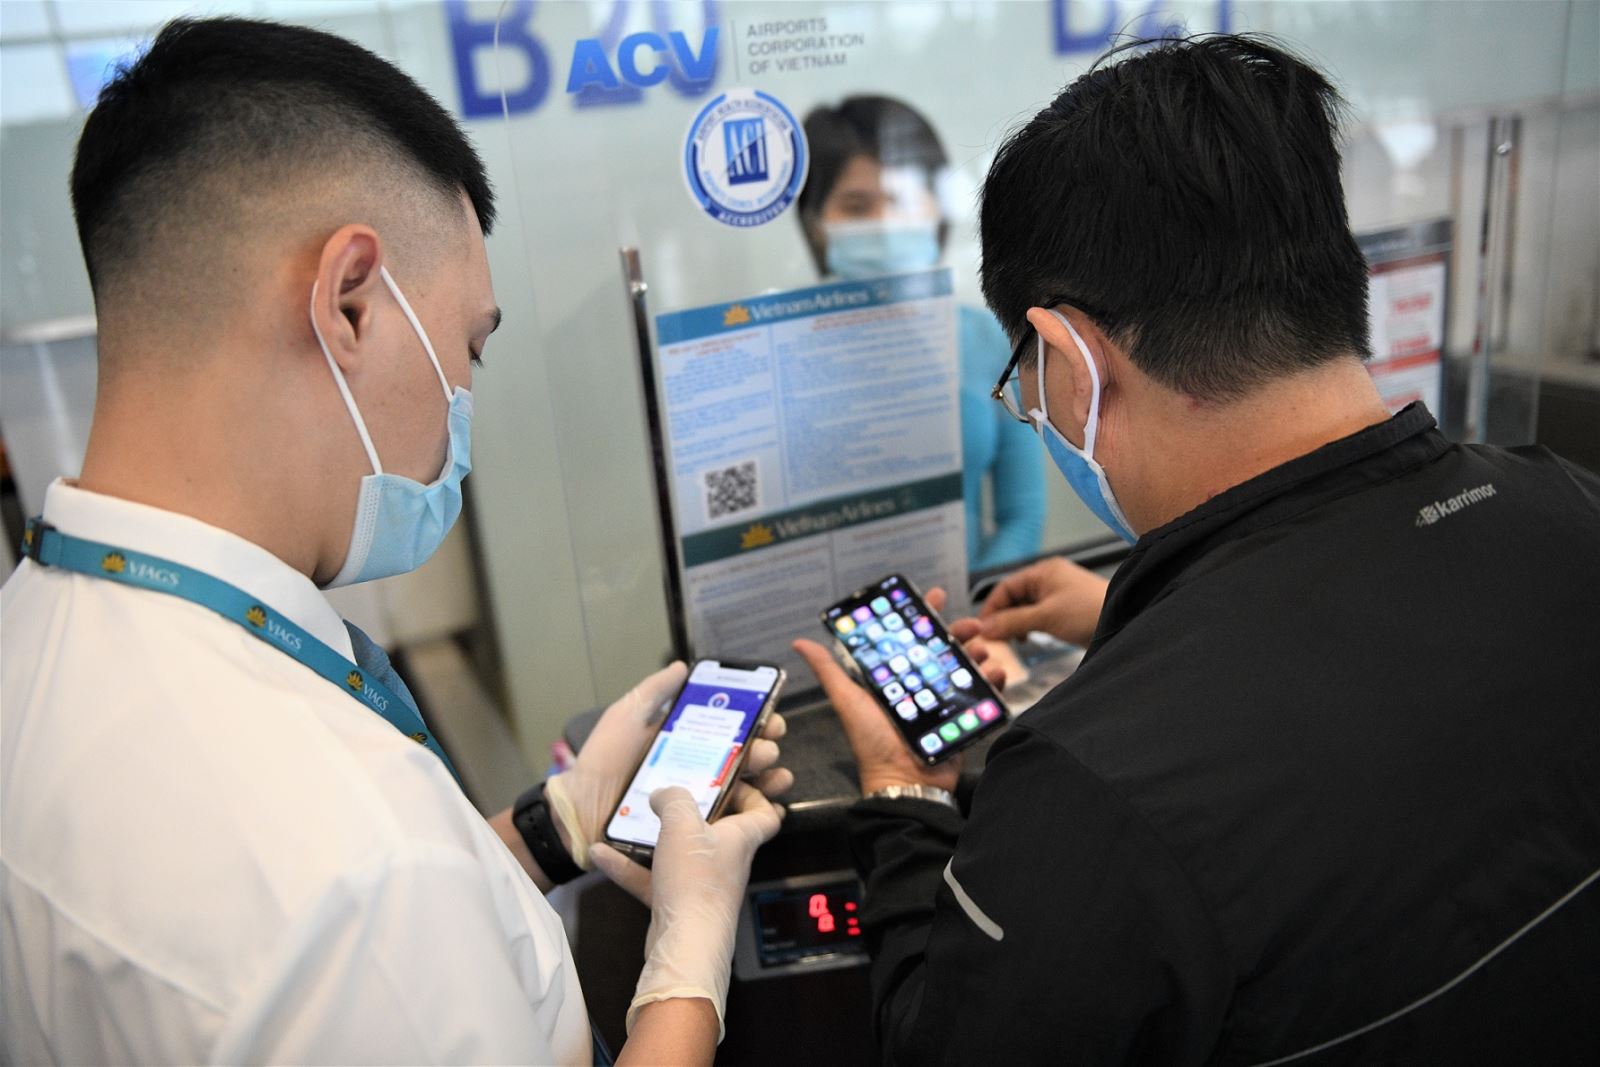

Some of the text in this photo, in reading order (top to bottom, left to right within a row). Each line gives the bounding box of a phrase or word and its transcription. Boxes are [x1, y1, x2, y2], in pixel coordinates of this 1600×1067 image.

[747, 18, 828, 38] AIRPORTS
[747, 33, 865, 57] CORPORATION
[565, 26, 720, 94] ACV
[748, 53, 848, 75] OF VIETNAM
[129, 560, 181, 586] VIAGS
[268, 619, 302, 650] VIAGS
[363, 683, 388, 711] VIAGS
